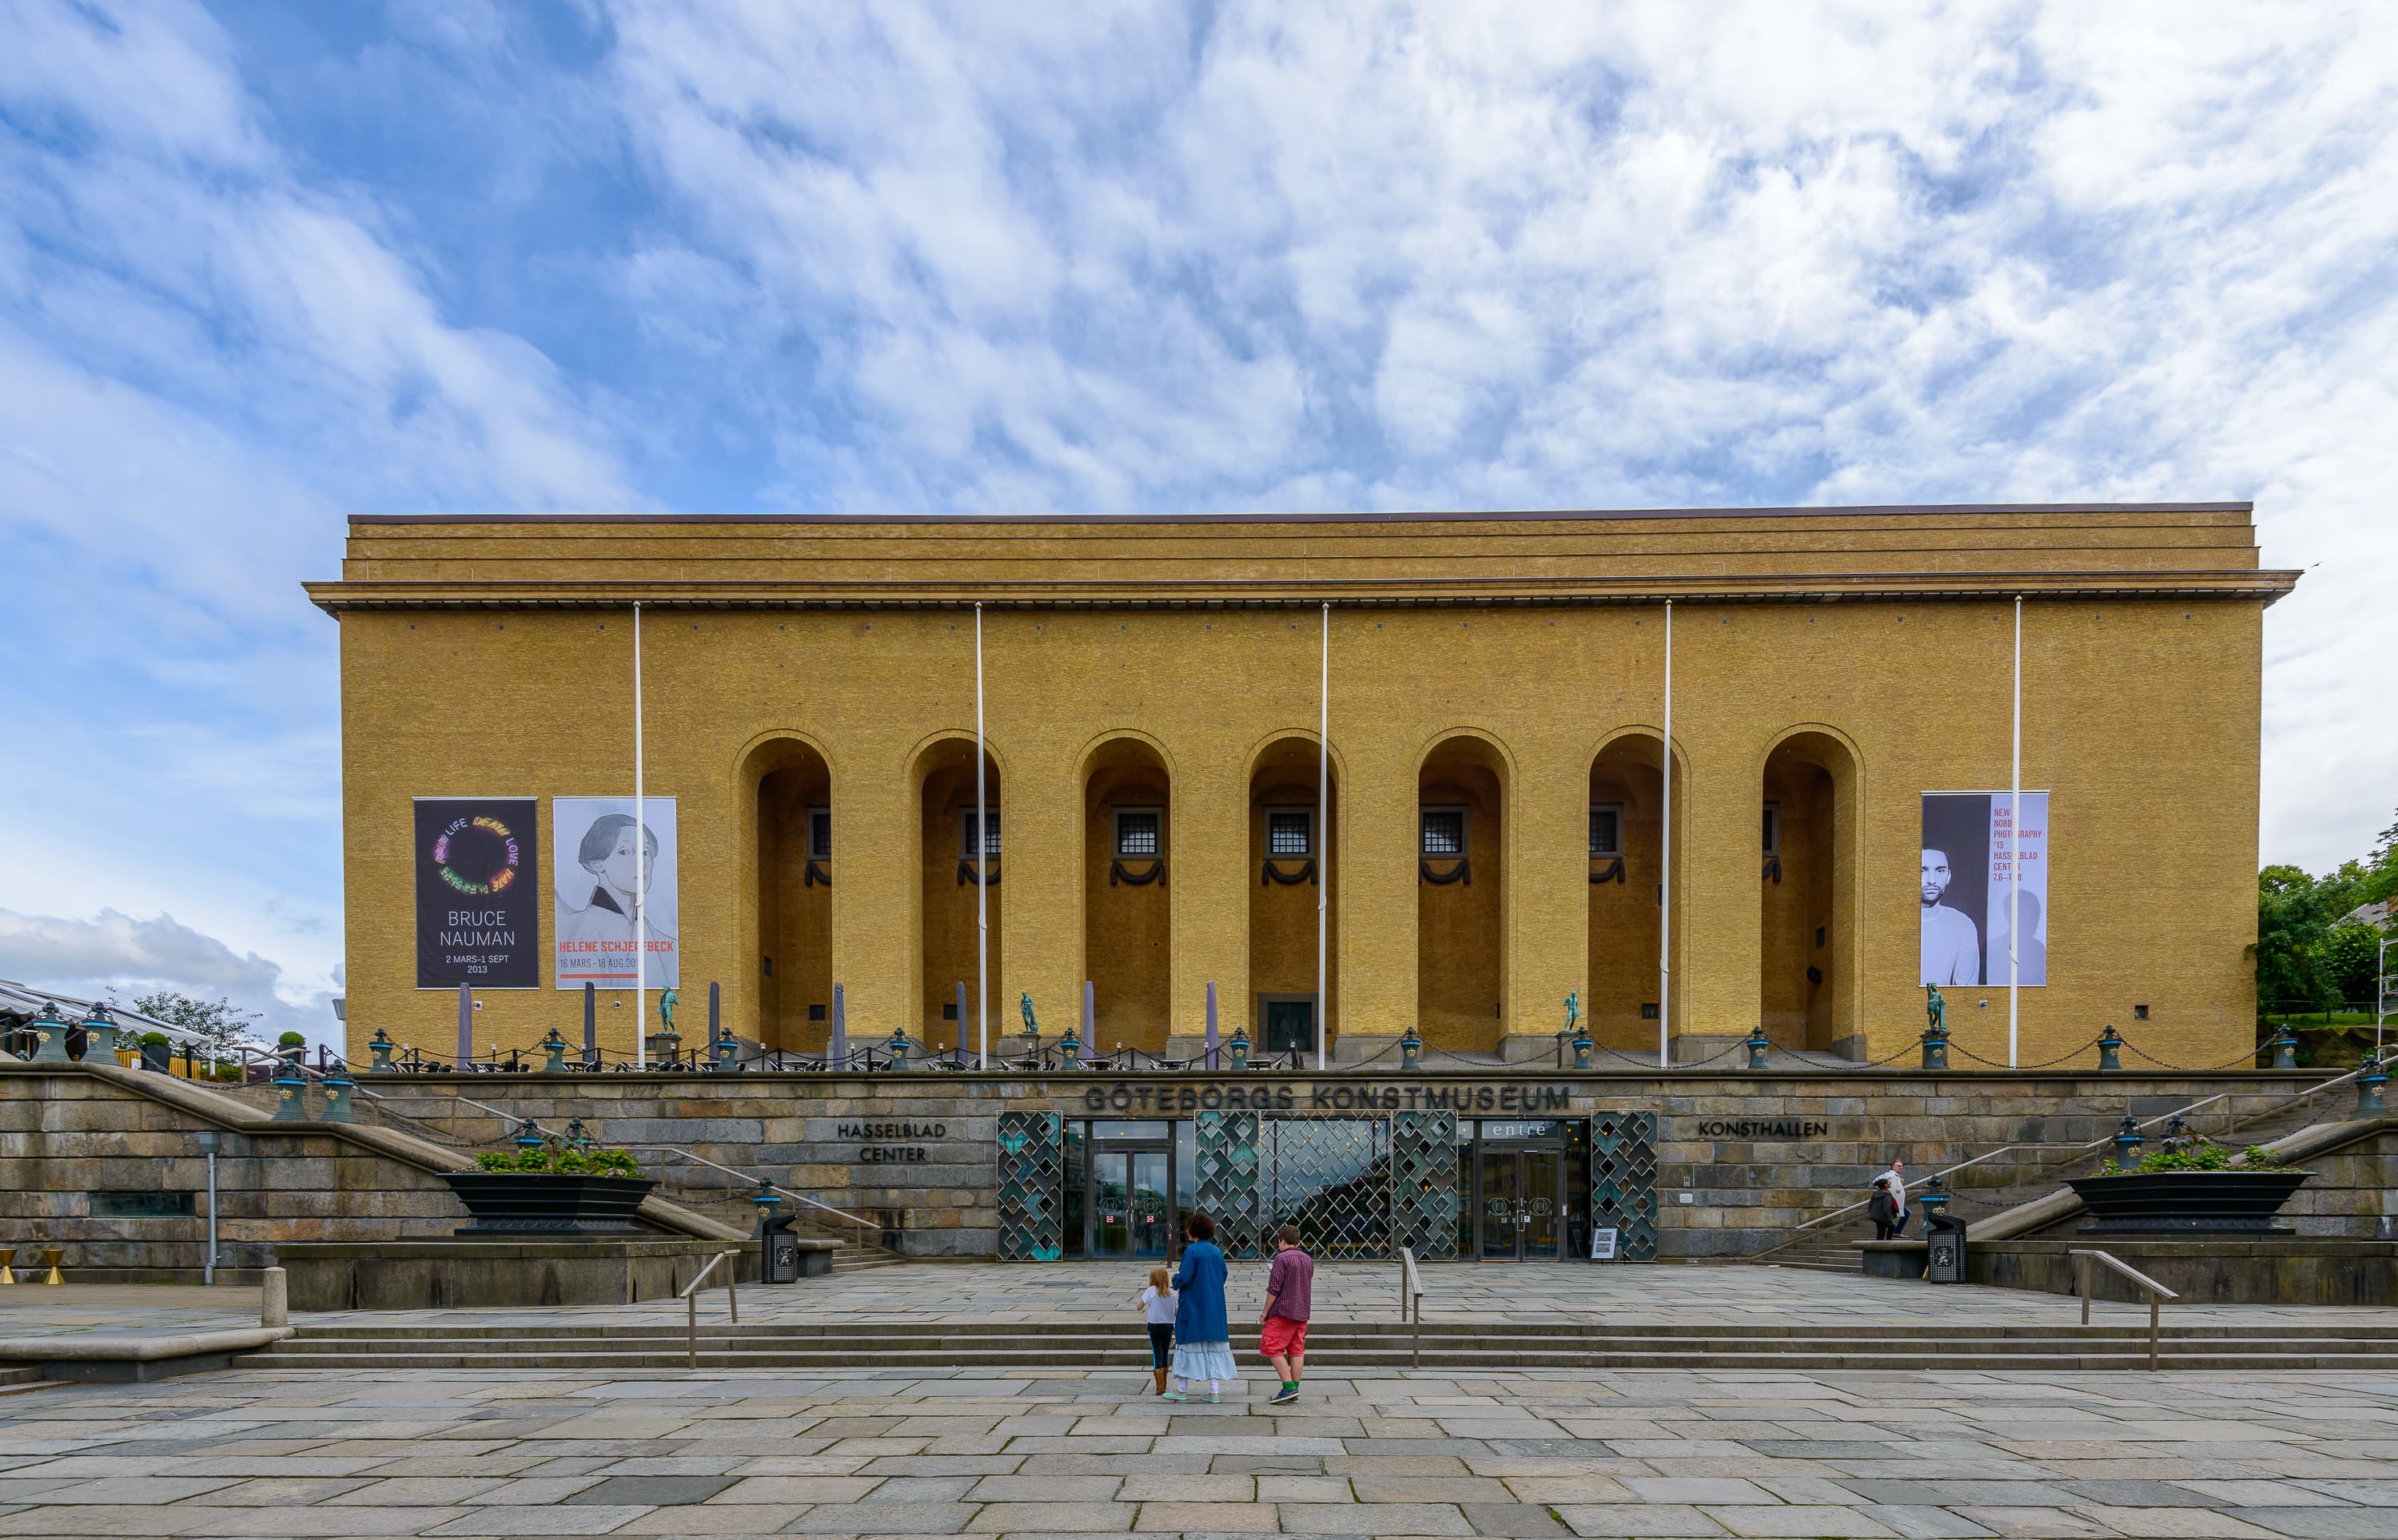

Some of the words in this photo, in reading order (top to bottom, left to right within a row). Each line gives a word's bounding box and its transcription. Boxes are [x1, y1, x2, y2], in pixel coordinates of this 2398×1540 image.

[1994, 808, 2010, 817] NEW
[445, 818, 468, 835] LIFE
[1994, 819, 2013, 828] NORD
[506, 838, 519, 866] LOVE
[1994, 862, 2021, 871] CENT
[492, 868, 514, 892] HATE
[448, 910, 506, 926] BRUCE
[440, 931, 515, 946] NAUMAN
[560, 959, 568, 969] 16
[570, 959, 592, 969] MARS
[608, 959, 623, 969] AUG
[626, 959, 639, 969] 20
[1085, 1081, 1293, 1109] GÖTEBORGS
[1312, 1086, 1570, 1110] KONSTMUSEUM
[838, 1124, 946, 1138] HASSELBLAD
[1493, 1123, 1546, 1136] entré
[1699, 1121, 1828, 1136] KONSTHALLEN
[859, 1147, 926, 1161] CENTER
